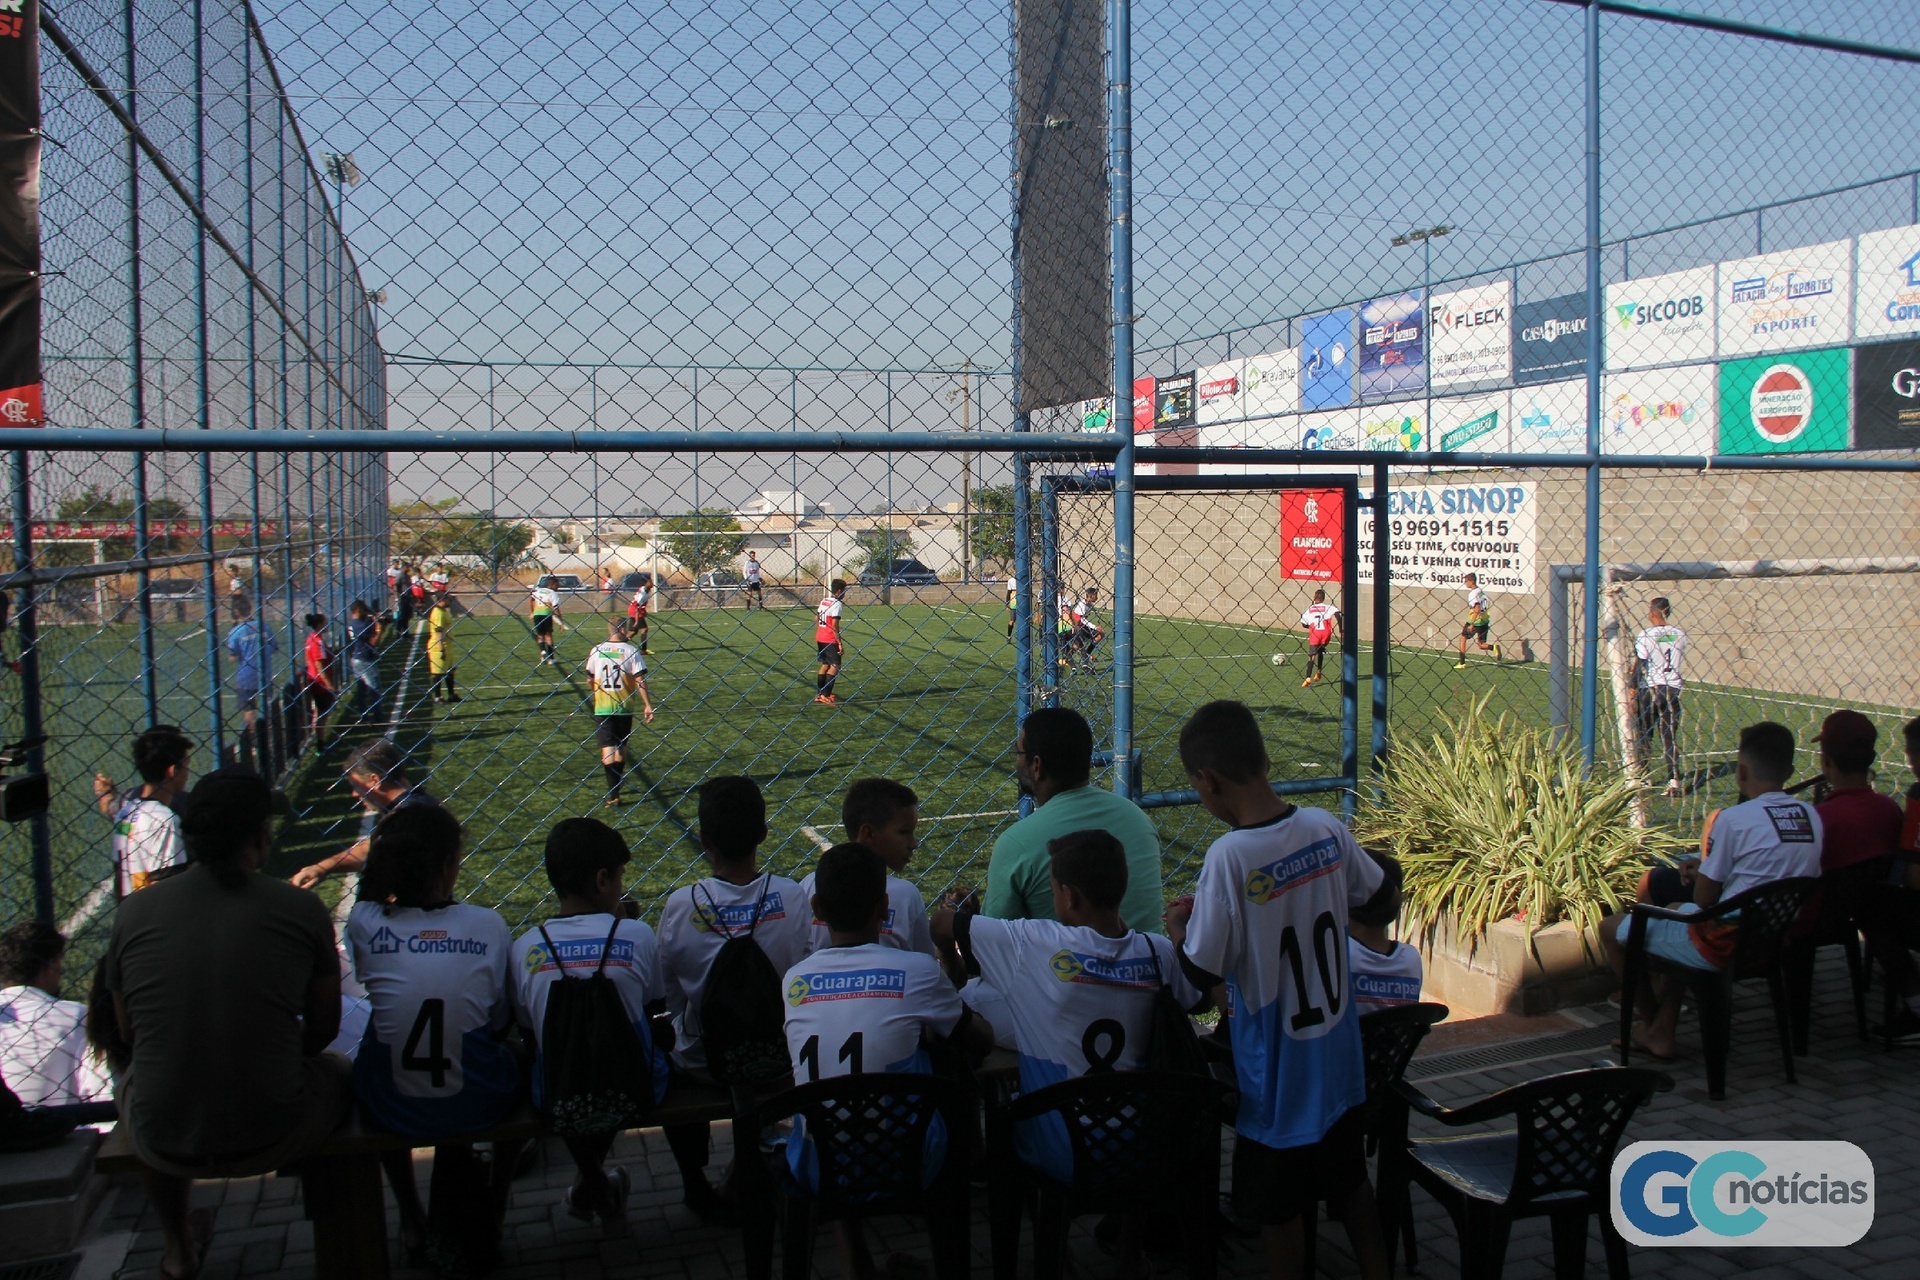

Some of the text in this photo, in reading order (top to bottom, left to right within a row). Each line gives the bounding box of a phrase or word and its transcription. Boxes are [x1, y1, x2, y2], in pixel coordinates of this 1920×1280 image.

[1455, 307, 1505, 329] FLECK
[1636, 295, 1703, 325] SICOOB
[1522, 326, 1545, 342] CASA
[1753, 315, 1818, 334] ESPORTE
[1357, 487, 1525, 515] ENA SINOP
[1406, 520, 1509, 536] 9691-1515
[1293, 537, 1333, 549] FLAMENGO
[1391, 540, 1412, 551] SEU
[1451, 541, 1520, 553] CONVOQUE
[1422, 557, 1461, 568] VENHA
[1465, 557, 1511, 569] CURTIR
[1389, 569, 1423, 583] Society
[1478, 573, 1523, 587] Eventos
[1664, 648, 1673, 673] 1
[602, 664, 622, 689] 12
[1767, 805, 1806, 818] HAPPY
[717, 893, 783, 923] Guarari
[407, 935, 488, 956] Construtor
[810, 972, 904, 991] Guarapari
[1280, 910, 1342, 1033] 10
[1356, 975, 1420, 999] Guarapar
[402, 998, 452, 1088] 4
